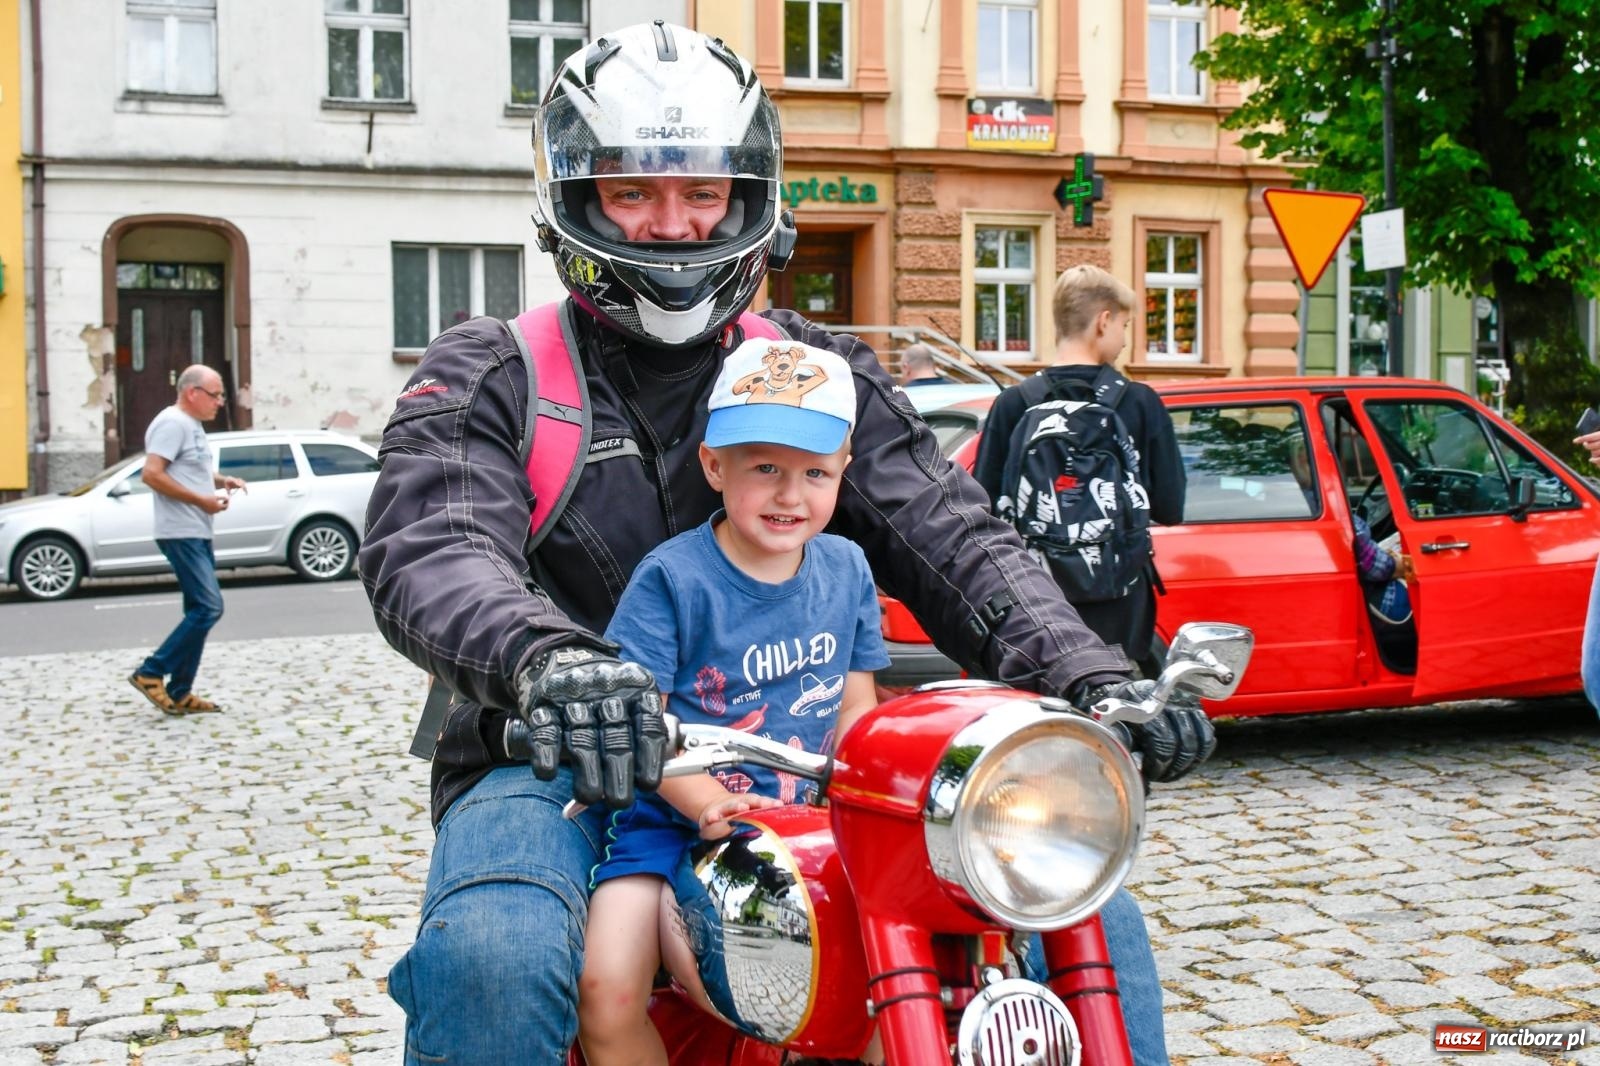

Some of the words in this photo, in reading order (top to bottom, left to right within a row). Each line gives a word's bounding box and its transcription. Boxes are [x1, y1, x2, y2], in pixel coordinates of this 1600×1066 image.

[635, 126, 710, 139] SHARK
[973, 124, 1050, 142] KRANOWITZ
[1036, 490, 1055, 523] NIKE
[1100, 481, 1117, 511] NIKE
[743, 632, 836, 686] CHILLED
